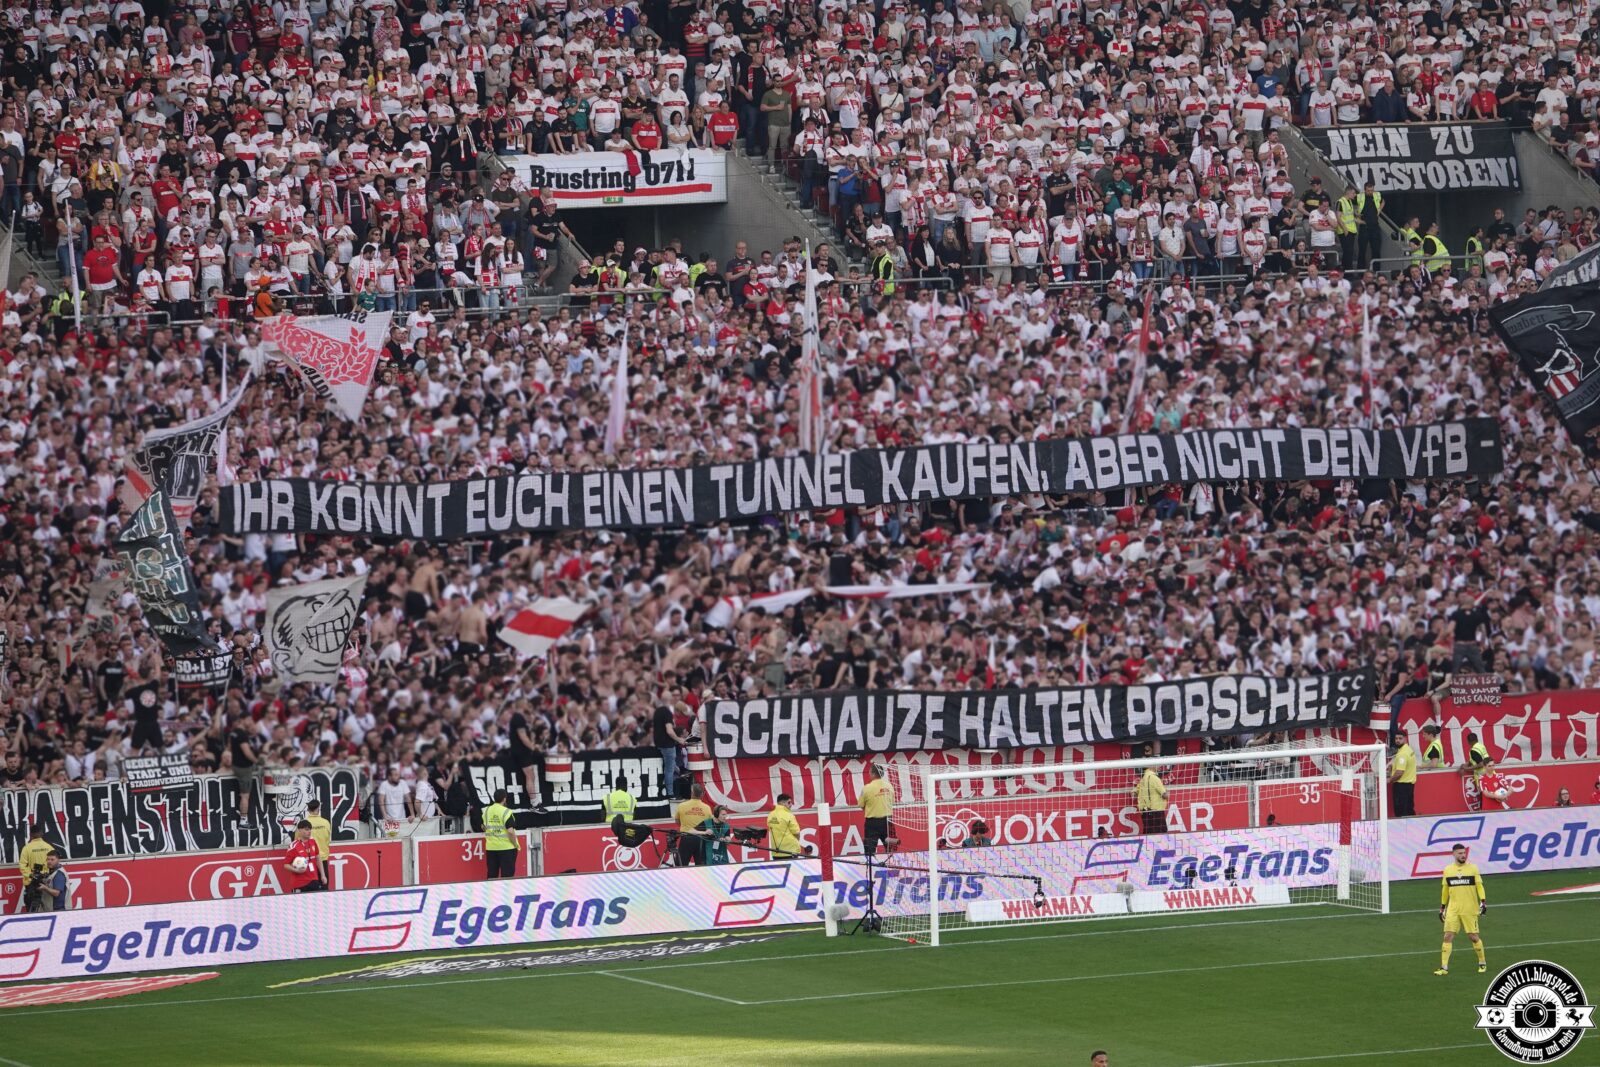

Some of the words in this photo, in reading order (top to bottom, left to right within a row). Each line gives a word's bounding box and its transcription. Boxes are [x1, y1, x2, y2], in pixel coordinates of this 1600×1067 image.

[1327, 127, 1411, 161] NEIN
[1430, 126, 1474, 155] ZU
[530, 165, 636, 193] Brustring
[644, 158, 696, 186] 0711
[234, 480, 295, 532] IHR
[308, 481, 450, 537] KÖNNT
[467, 475, 569, 533] EUCH
[584, 469, 695, 527] EINEN
[710, 453, 865, 518] TUNNEL
[880, 443, 1049, 503] KAUFEN,
[1065, 434, 1169, 490] ABER
[1175, 430, 1286, 480] NICHT
[1301, 428, 1381, 477] DEN
[1399, 423, 1468, 476] VfB
[1337, 674, 1364, 691] CC
[714, 694, 946, 758] SCHNAUZE
[959, 686, 1114, 748] HALTEN
[1127, 676, 1329, 736] PORSCHE!
[1336, 695, 1361, 712] 97
[125, 757, 158, 769] GEGEN
[161, 754, 189, 766] ALLE
[127, 768, 167, 780] STADT-
[168, 764, 191, 776] UND
[1300, 783, 1320, 804] 35
[990, 802, 1214, 846] JOKERSAR
[461, 839, 484, 861] 34
[1488, 822, 1600, 871] EgeTr
[1147, 844, 1333, 890] EgeTrans
[1002, 895, 1095, 920] WINAMAX
[1164, 885, 1256, 910] WINAMAX
[432, 894, 630, 945] EgeTrans
[61, 920, 262, 973] EgeTrans
